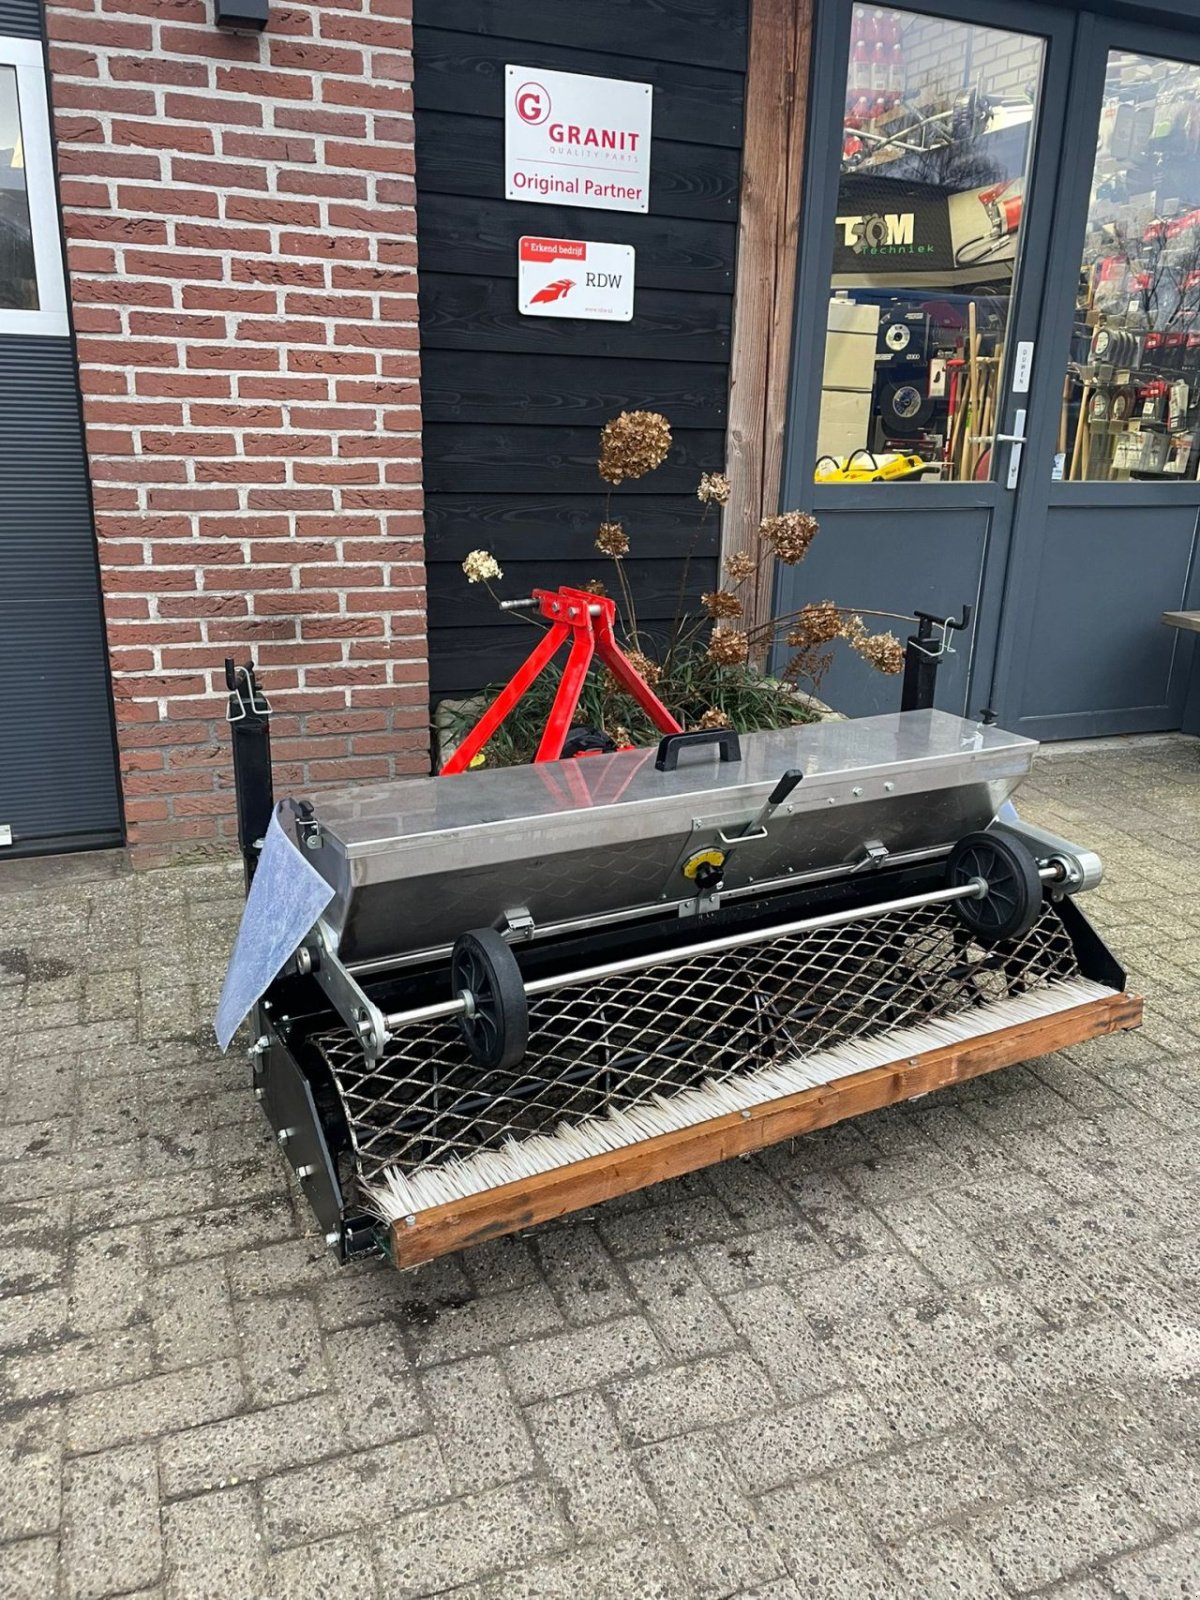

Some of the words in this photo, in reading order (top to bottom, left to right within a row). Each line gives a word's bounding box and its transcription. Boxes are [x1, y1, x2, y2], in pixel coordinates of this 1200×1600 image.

[518, 93, 542, 121] G
[548, 123, 640, 152] GRANIT
[549, 146, 600, 159] QUALITY
[605, 153, 639, 164] PARTS
[513, 172, 580, 195] Original
[584, 179, 643, 200] Partner
[530, 242, 558, 253] Erkend
[558, 244, 584, 257] bedrijf
[862, 244, 935, 256] Techniek
[585, 272, 623, 290] RDW
